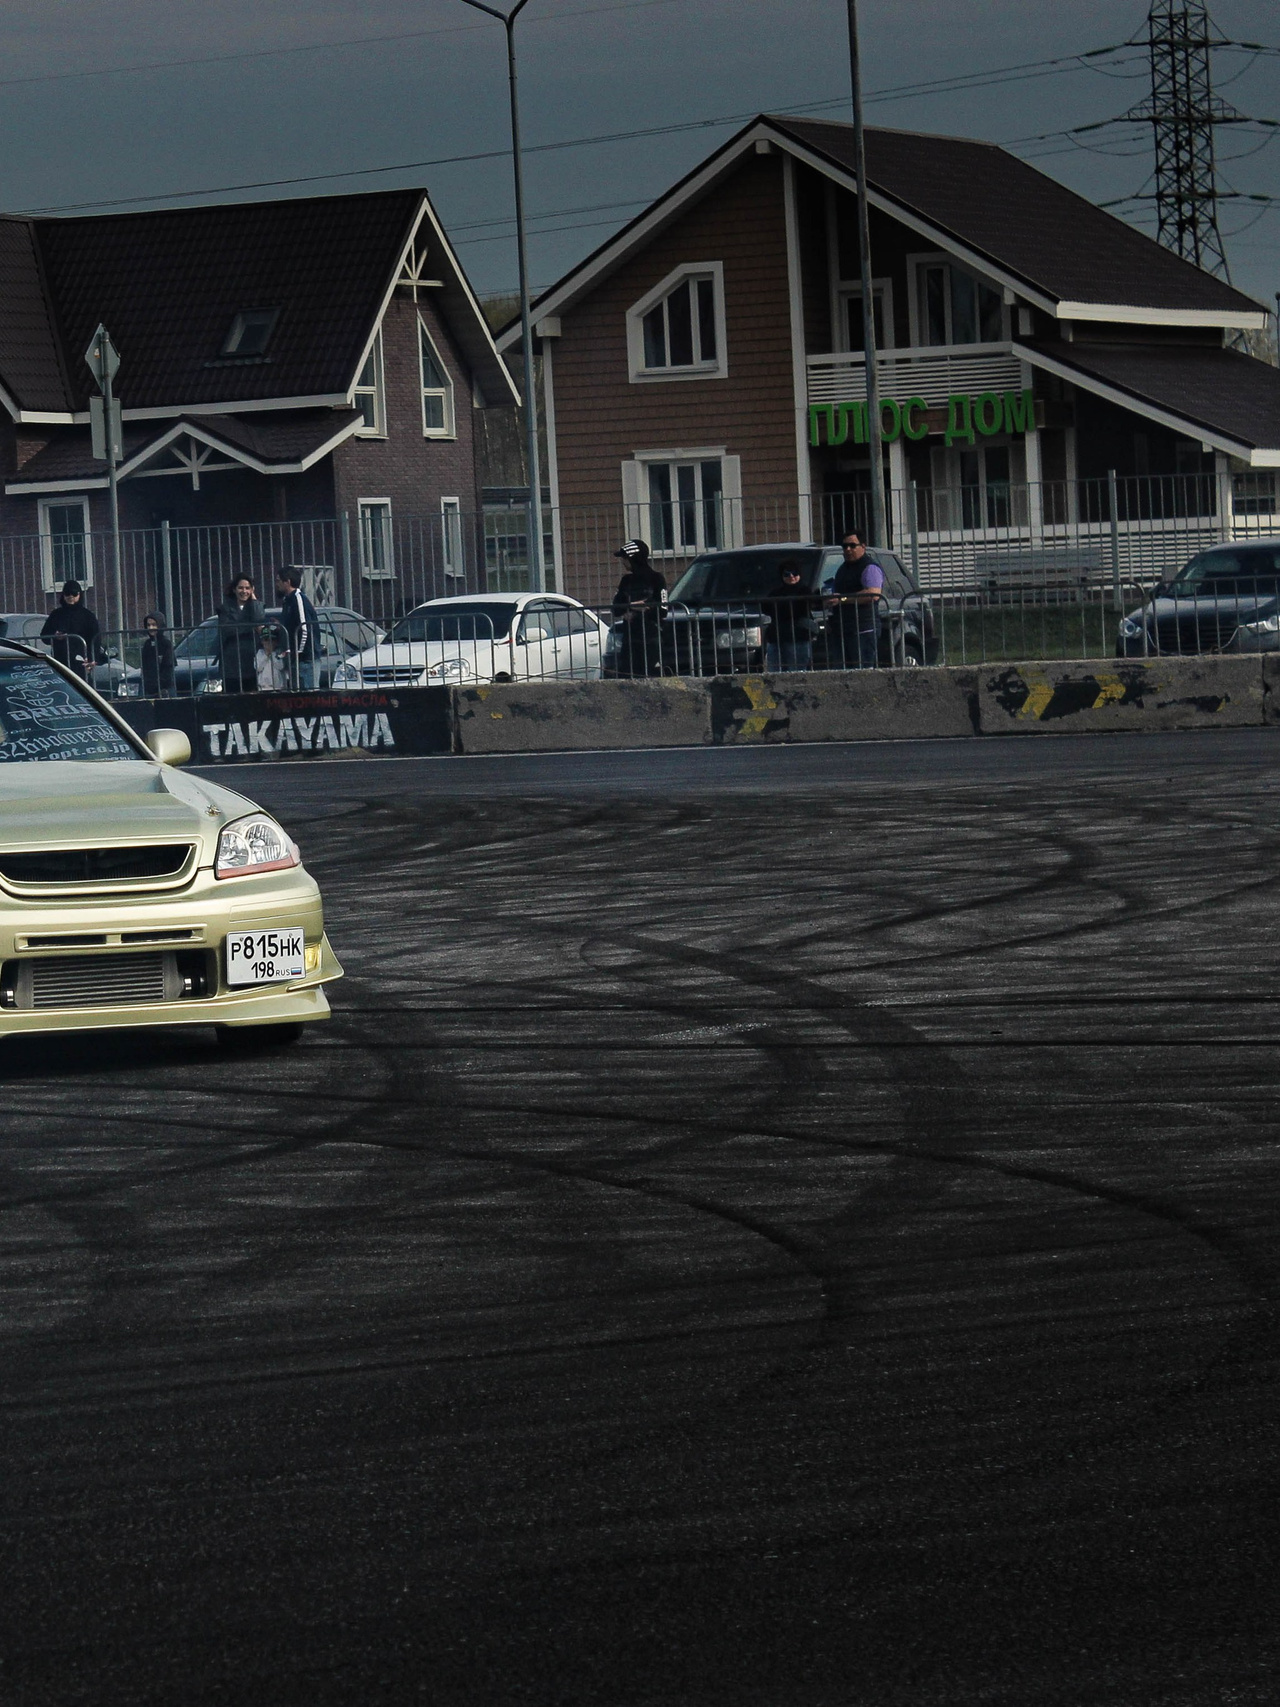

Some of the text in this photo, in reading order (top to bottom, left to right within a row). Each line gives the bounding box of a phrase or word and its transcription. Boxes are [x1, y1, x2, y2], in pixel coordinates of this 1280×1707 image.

[809, 389, 1036, 447] ПЛЮС ДОМ
[7, 703, 99, 721] BRIDE
[202, 712, 395, 756] TAKAYAMA
[251, 961, 274, 978] 198
